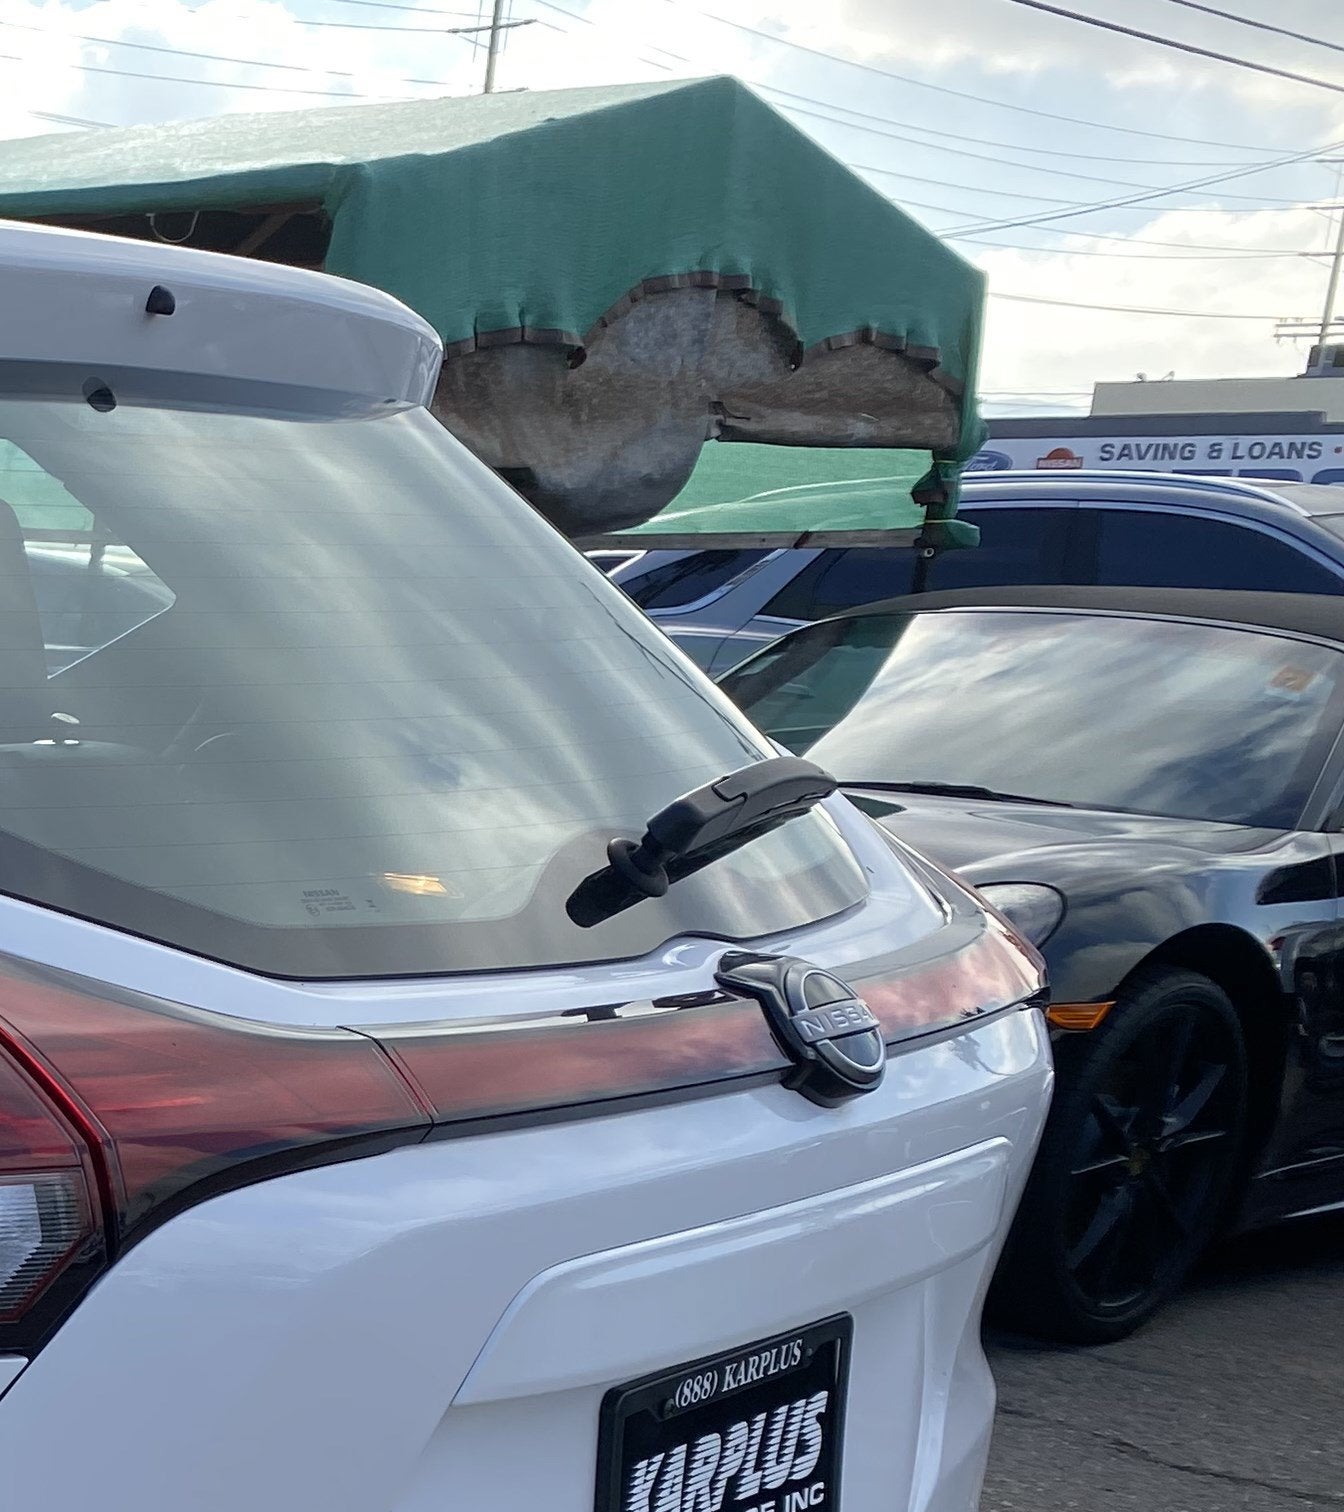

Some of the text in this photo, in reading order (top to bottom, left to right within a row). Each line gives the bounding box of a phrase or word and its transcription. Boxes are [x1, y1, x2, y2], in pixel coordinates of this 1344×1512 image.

[1099, 440, 1323, 462] SAVING & LOANS
[801, 1005, 872, 1037] NISSA
[675, 1339, 804, 1408] (888) KARPLUS
